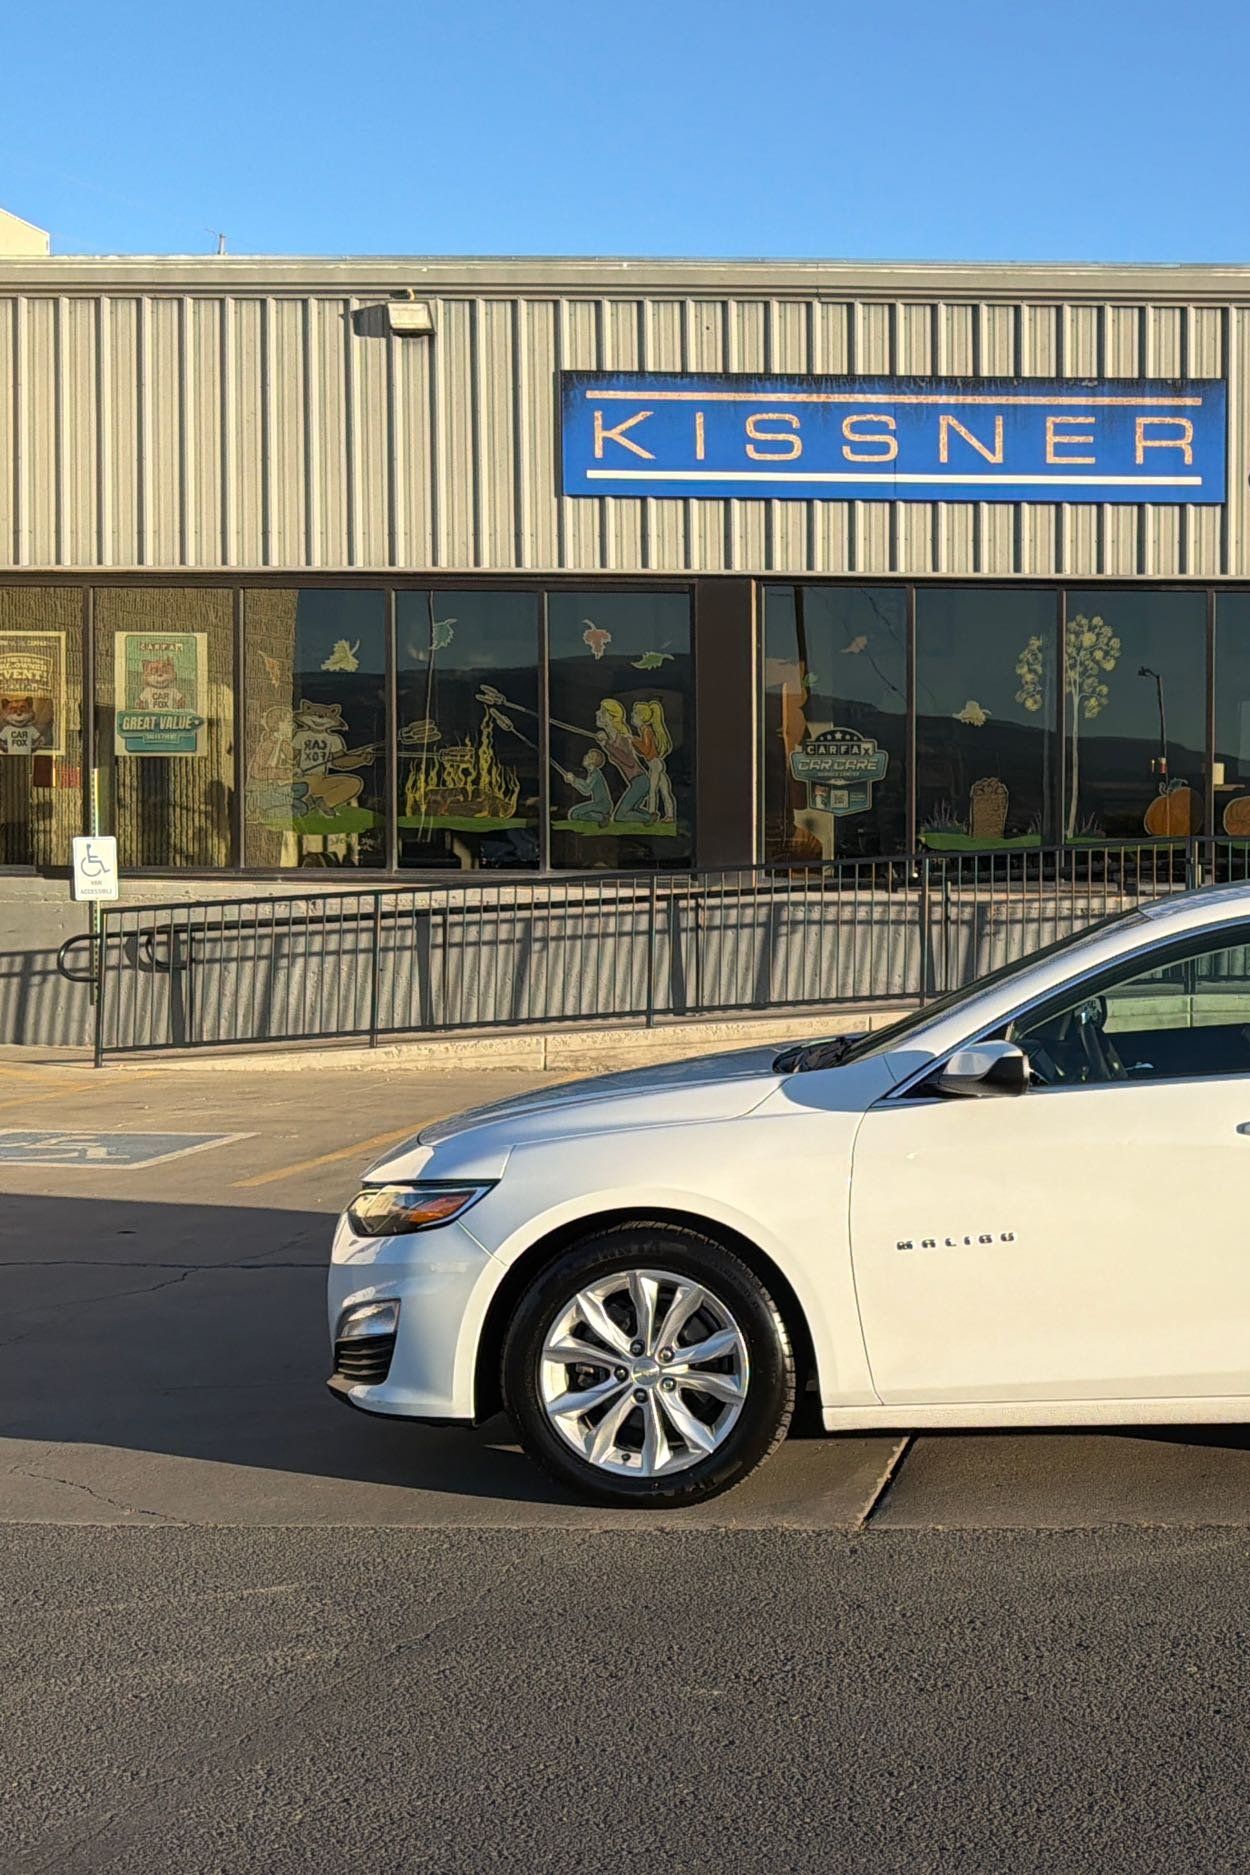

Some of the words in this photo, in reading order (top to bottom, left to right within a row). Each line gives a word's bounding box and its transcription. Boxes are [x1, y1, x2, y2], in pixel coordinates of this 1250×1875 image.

[593, 410, 1194, 465] KISSNER
[151, 692, 170, 700] CAR
[152, 701, 169, 709] FOX
[122, 716, 157, 730] GREAT
[160, 716, 193, 730] VALUE
[11, 731, 28, 739] CAR
[806, 744, 875, 755] CARFAX
[798, 759, 832, 770] CAR
[833, 759, 878, 770] CARE
[896, 1232, 1015, 1251] MALIBU
